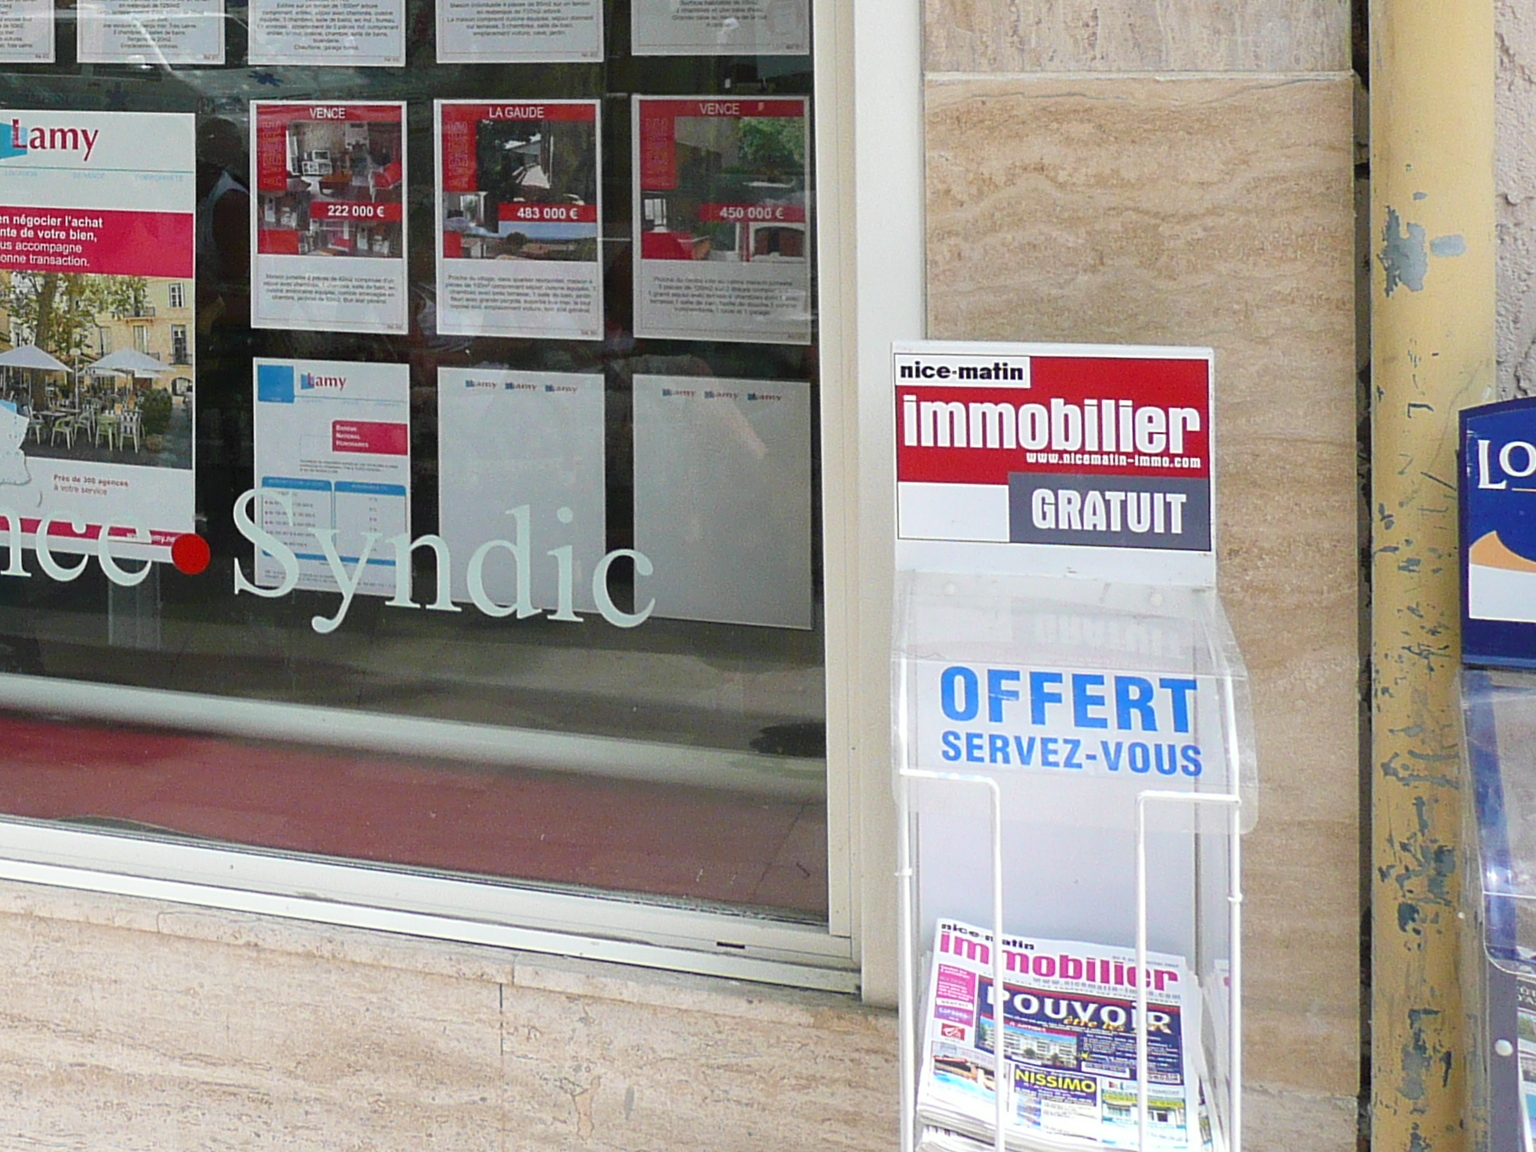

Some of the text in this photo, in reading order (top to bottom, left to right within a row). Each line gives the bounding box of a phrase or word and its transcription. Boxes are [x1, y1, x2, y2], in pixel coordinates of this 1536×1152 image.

[310, 108, 345, 119] VENCE
[489, 107, 544, 118] LA GAUDE
[700, 103, 740, 115] VENCE
[12, 118, 98, 161] Lamy
[328, 205, 384, 217] 222 000 €
[517, 207, 578, 219] 483 000 €
[719, 207, 784, 219] 450 000 €
[13, 214, 62, 228] négocier
[65, 215, 103, 228] l'achat
[20, 228, 35, 238] de
[38, 229, 66, 240] votre
[70, 229, 98, 243] bien,
[15, 241, 82, 255] accompagne
[29, 254, 90, 266] transaction.
[900, 361, 1023, 381] nice-matin
[307, 373, 346, 390] Lamy
[903, 394, 1200, 453] immobilier
[1026, 452, 1201, 468] www.nicematin-immo.com
[1031, 488, 1187, 534] GRATUIT
[233, 488, 656, 634] Syndic
[940, 666, 1198, 733] OFFERT
[942, 730, 1203, 777] SERVEZ-VOUS
[1016, 1069, 1096, 1093] NISSIMO
